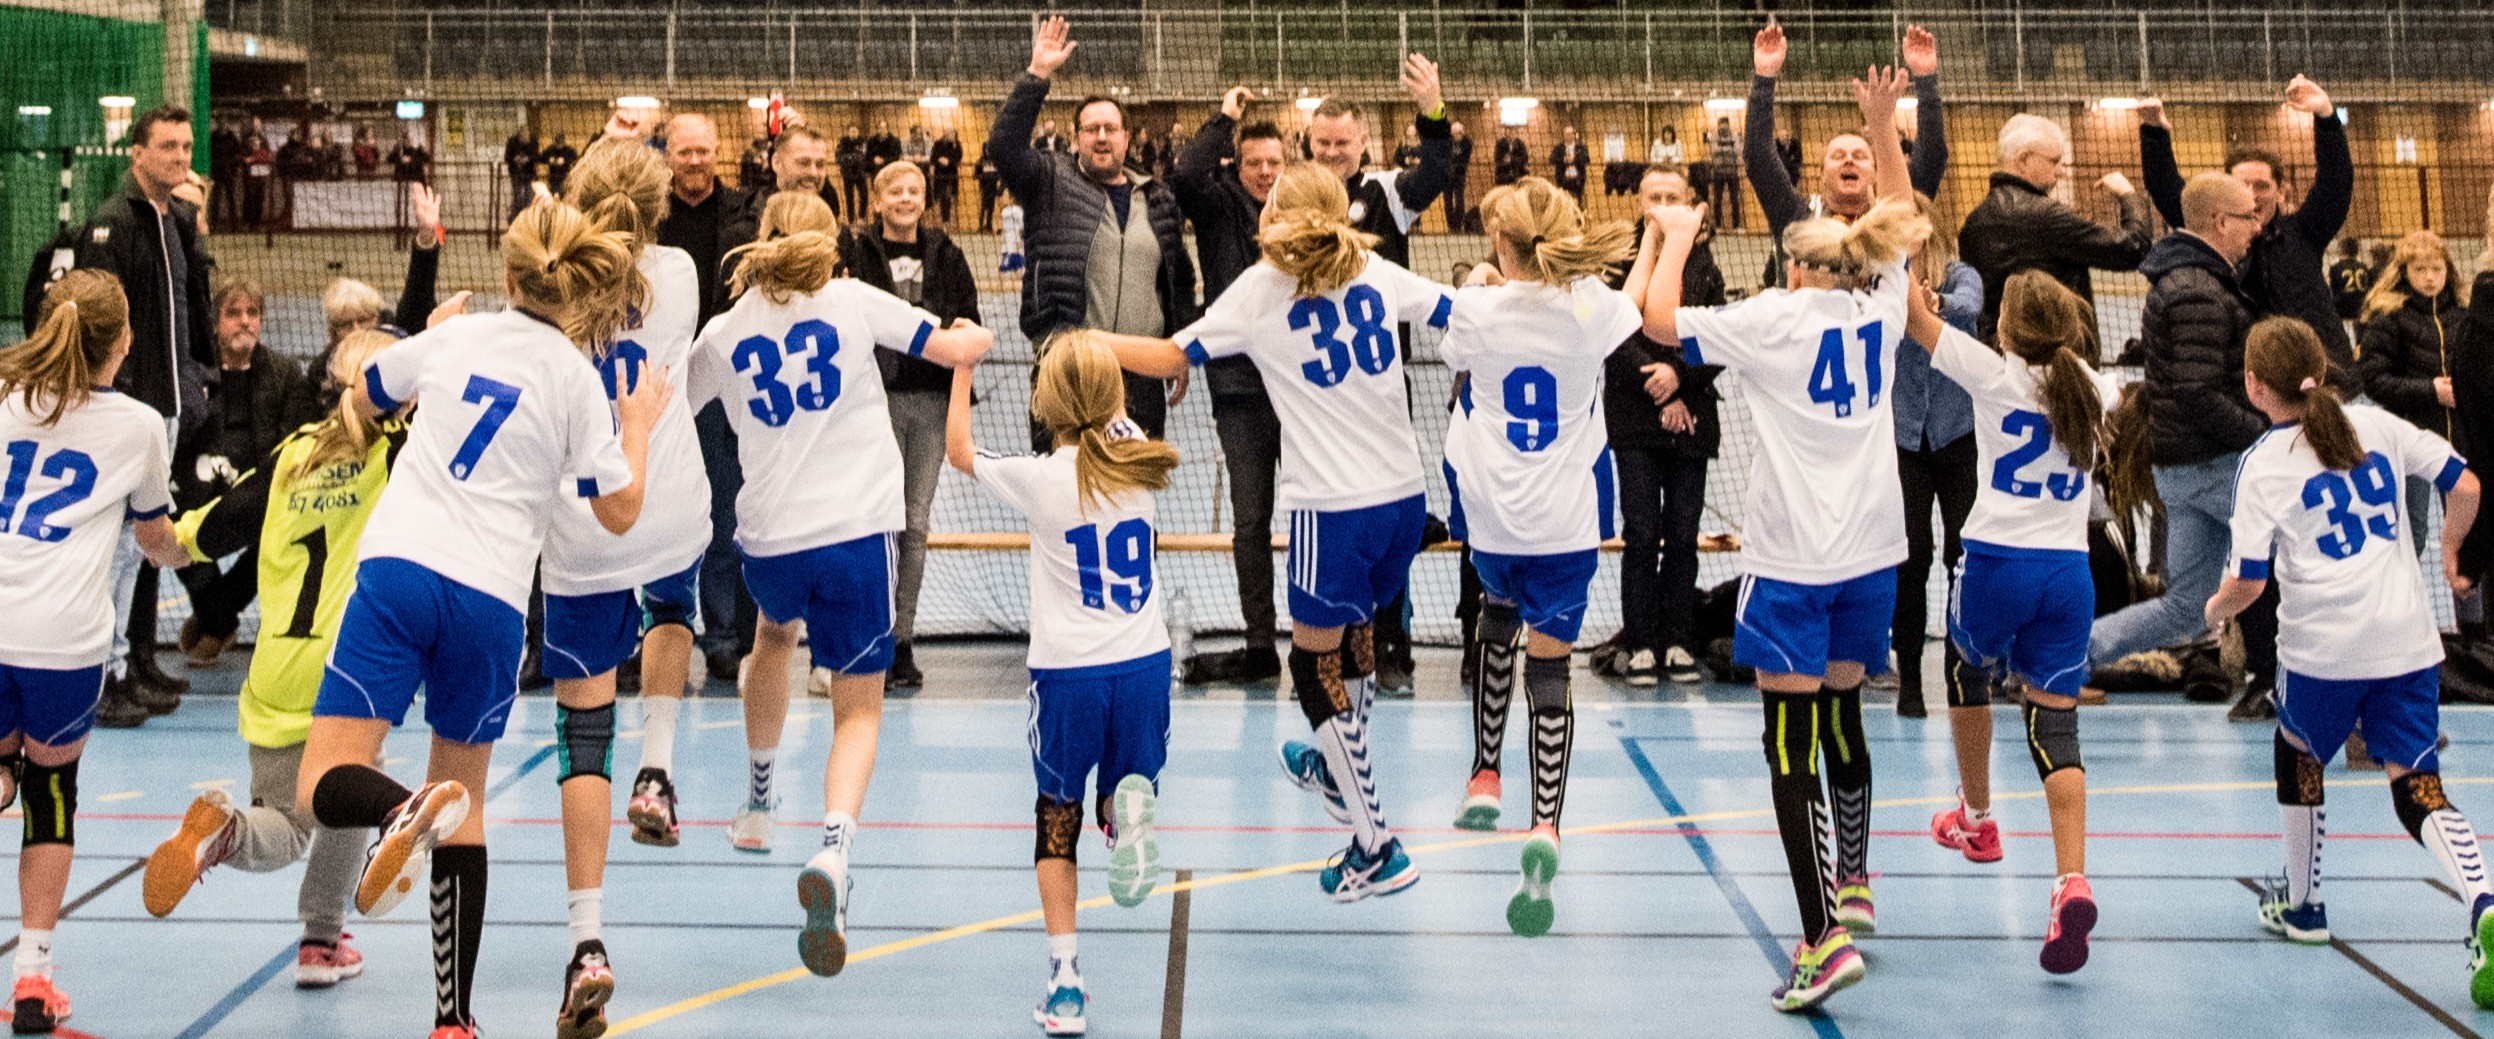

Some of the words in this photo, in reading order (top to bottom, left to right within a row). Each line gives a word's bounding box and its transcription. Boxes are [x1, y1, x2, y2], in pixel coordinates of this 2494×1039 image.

[731, 319, 841, 427] 33
[1288, 283, 1395, 388] 38
[1807, 320, 1882, 418] 41
[448, 374, 522, 481] 7
[1502, 366, 1558, 451] 9
[0, 439, 98, 542] 12
[2301, 450, 2398, 560] 39
[272, 525, 328, 639] 1
[1065, 517, 1153, 613] 19
